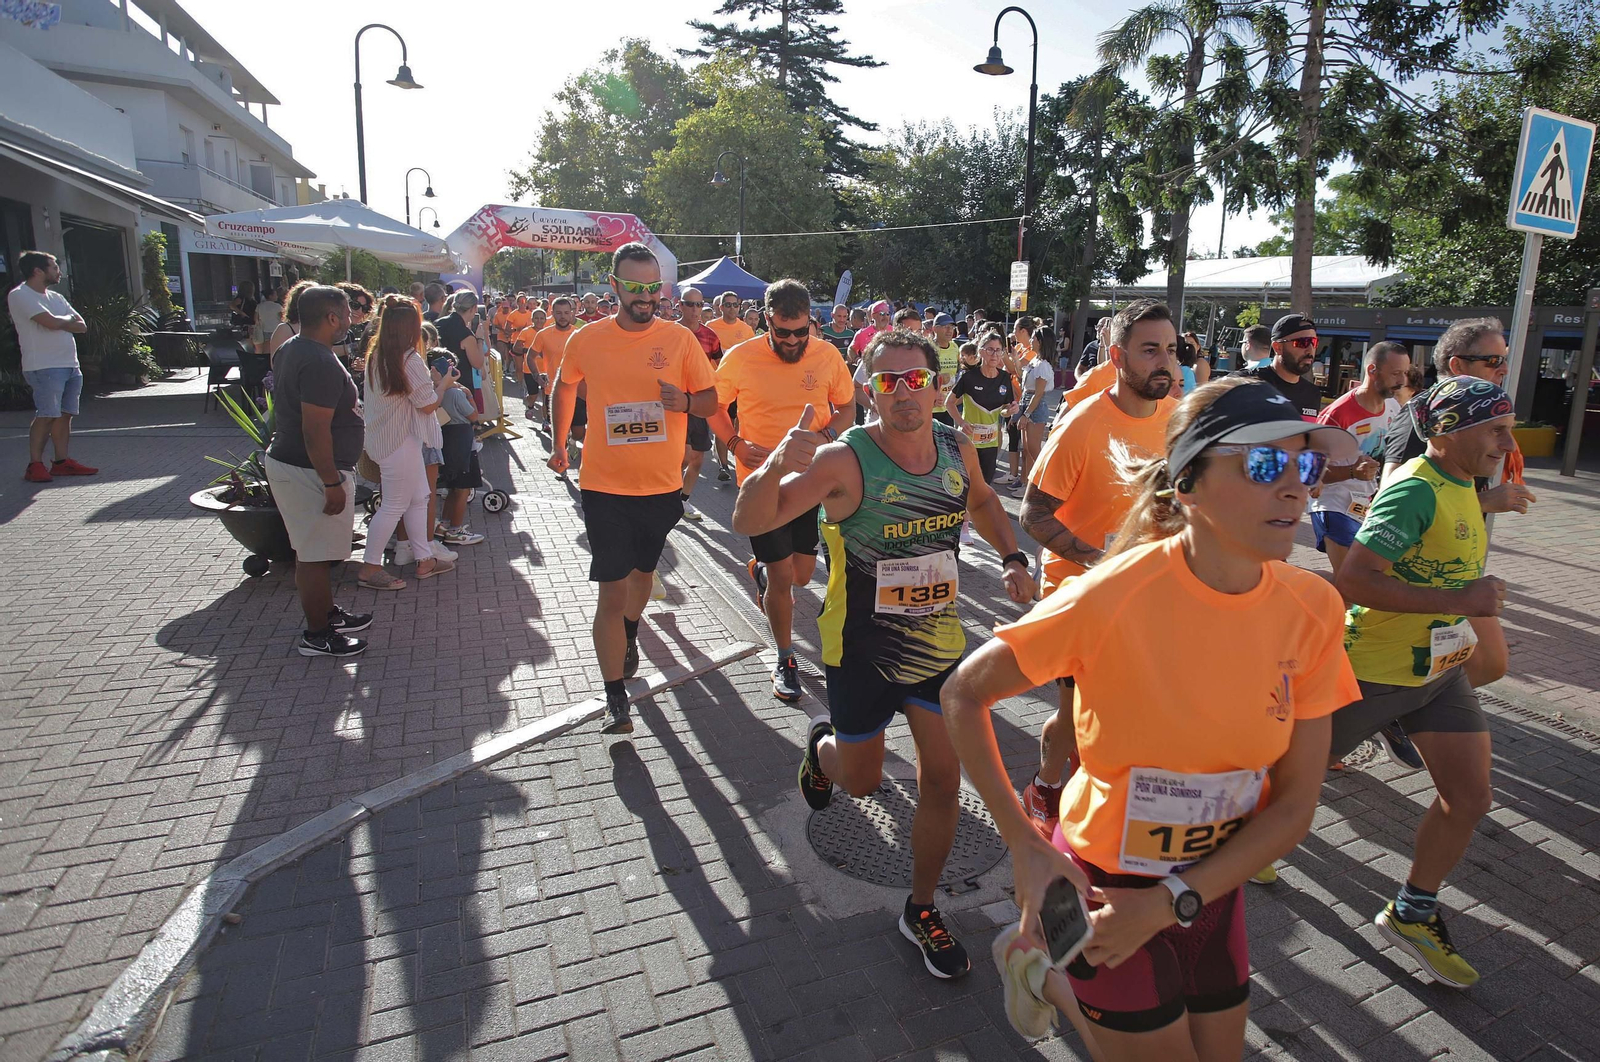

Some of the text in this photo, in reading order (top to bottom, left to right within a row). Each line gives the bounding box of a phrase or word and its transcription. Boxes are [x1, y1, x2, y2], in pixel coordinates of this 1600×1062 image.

[532, 211, 567, 225] Carrera
[218, 221, 276, 235] Cruzcampo
[542, 224, 603, 237] SOLIDARIA
[532, 234, 613, 246] DE PALMONES
[1406, 317, 1423, 325] La
[613, 422, 659, 435] 465
[883, 509, 966, 539] RUTEROS
[891, 582, 950, 603] 138
[1439, 647, 1471, 669] 148
[1135, 782, 1202, 799] POR UNA SONRISA
[1148, 817, 1244, 853] 123
